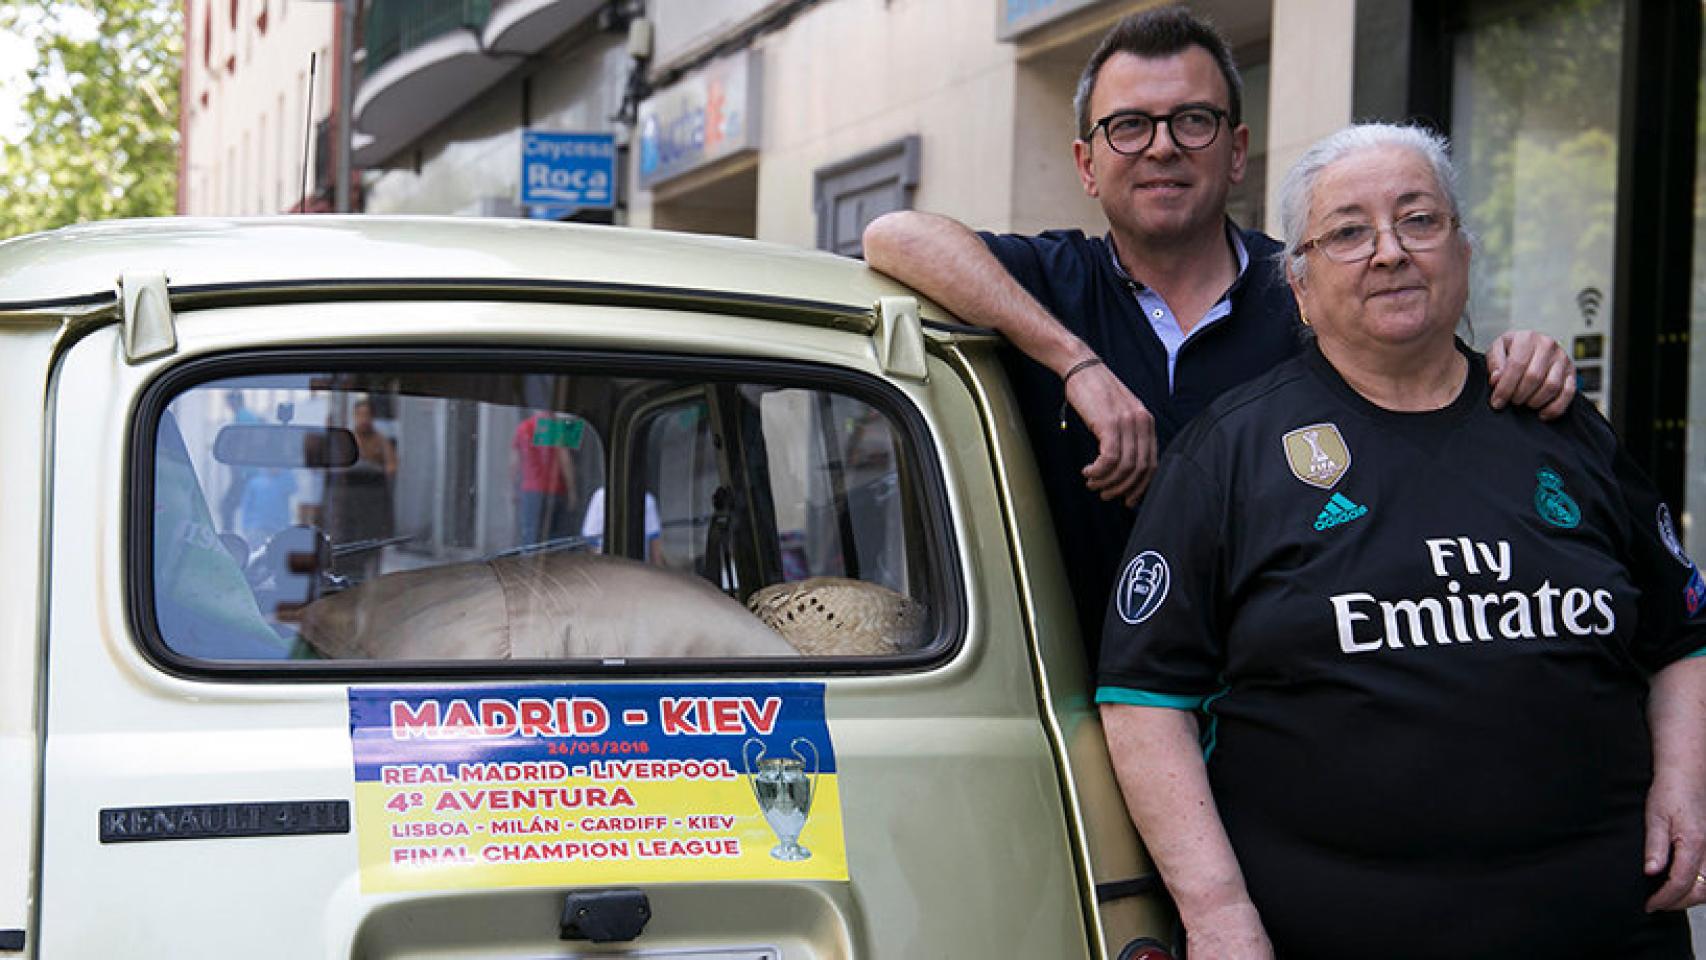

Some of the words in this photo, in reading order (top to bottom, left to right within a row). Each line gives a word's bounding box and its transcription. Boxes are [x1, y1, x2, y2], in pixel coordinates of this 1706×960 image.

[528, 163, 608, 191] Roca
[1313, 505, 1369, 531] adidas
[1425, 536, 1511, 581] Fly
[1329, 580, 1616, 653] Emirates
[391, 699, 609, 738] MADRID
[625, 711, 645, 724] -
[660, 698, 781, 735] KIEV
[548, 741, 649, 755] 26/05/2018
[383, 766, 453, 785] REAL
[460, 764, 565, 782] MADRID
[592, 762, 736, 780] LIVERPOOL
[435, 787, 635, 811] AVENTURA
[391, 822, 470, 838] LISBOA
[491, 815, 559, 833] MILÁN
[580, 816, 668, 832] CARDIFF
[687, 815, 735, 830] KIEV
[393, 846, 475, 865] FINAL
[481, 841, 629, 862] CHAMPION
[637, 840, 740, 857] LEAGUE
